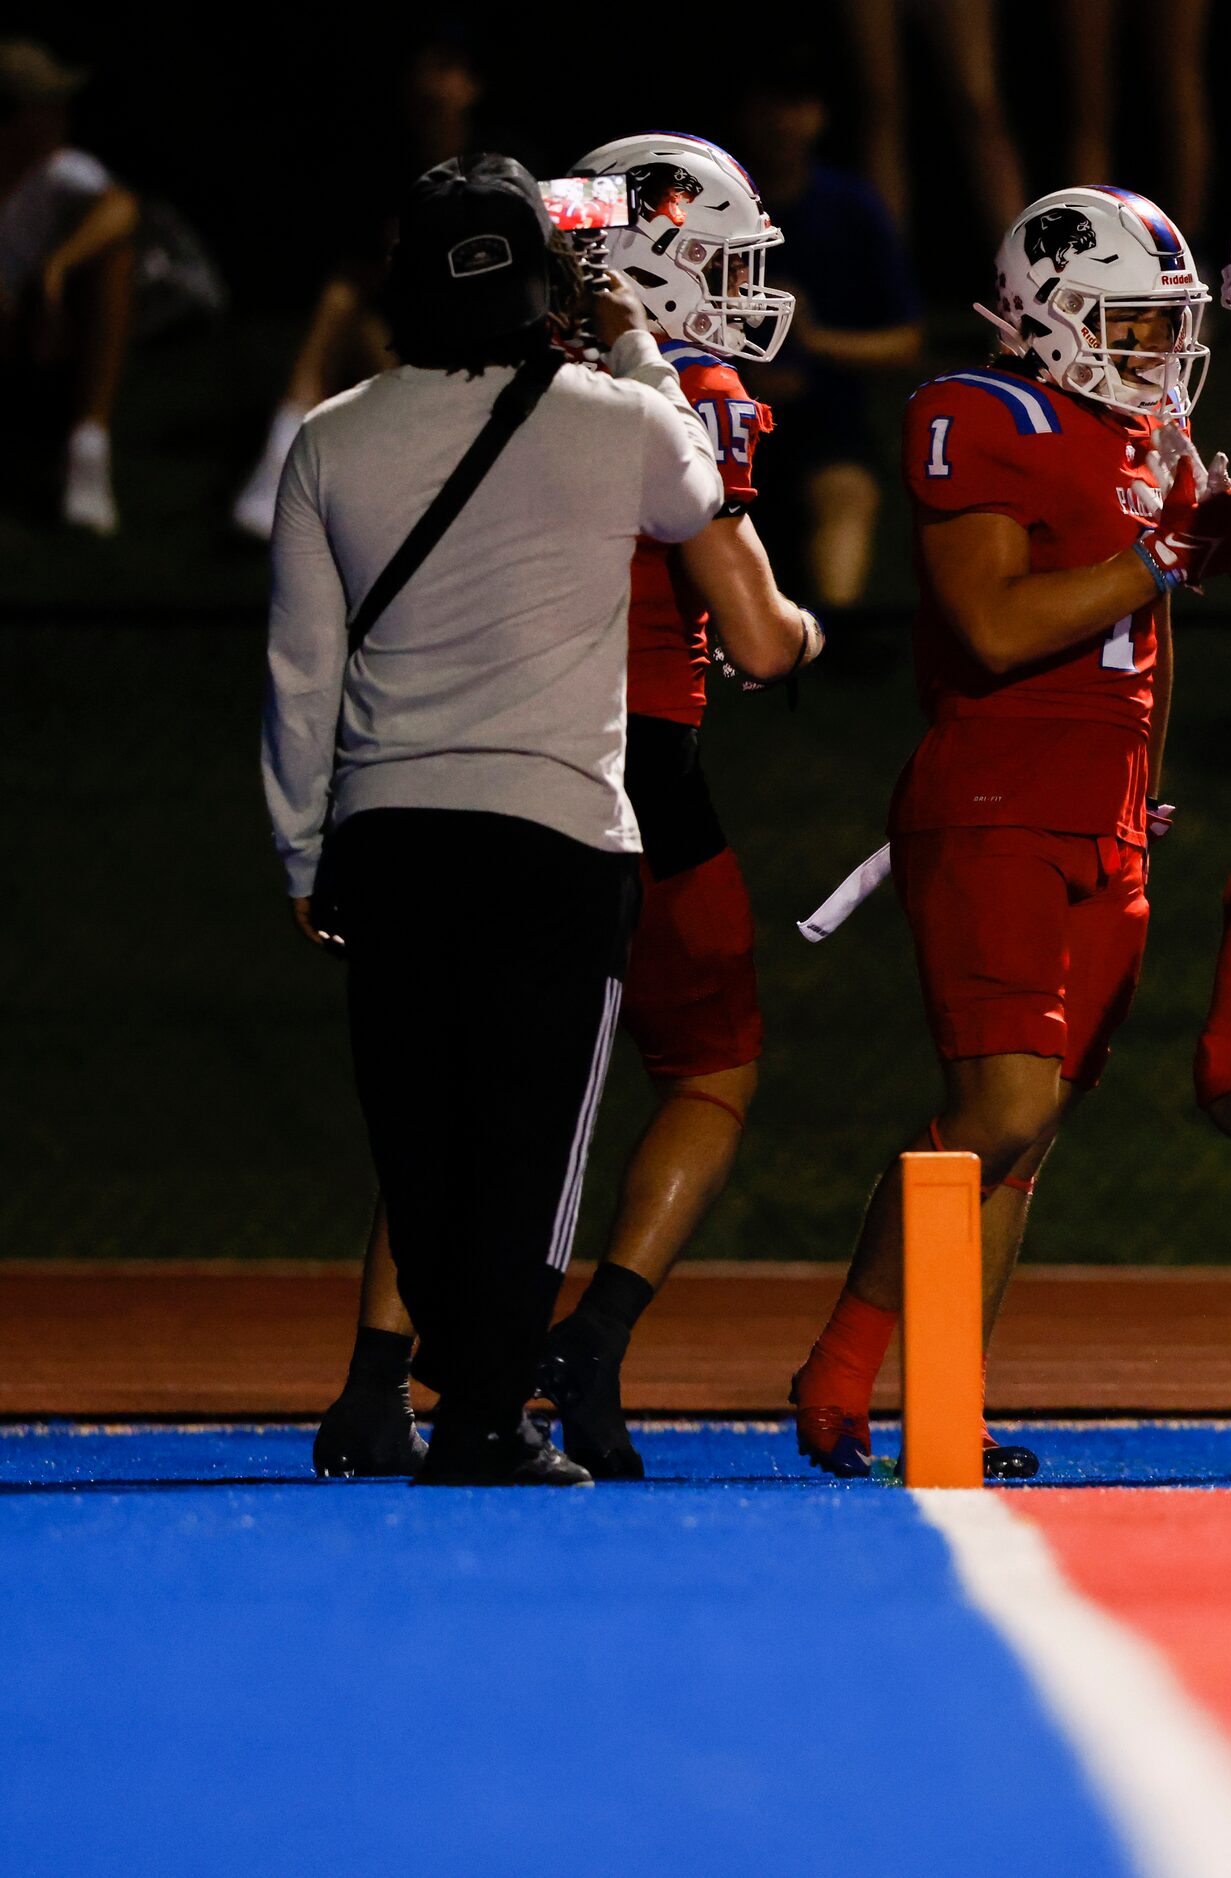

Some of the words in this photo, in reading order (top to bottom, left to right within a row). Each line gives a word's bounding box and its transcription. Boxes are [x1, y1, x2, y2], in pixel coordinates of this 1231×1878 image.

[1161, 273, 1193, 285] Riddell
[694, 399, 757, 466] 15
[926, 416, 953, 479] 1
